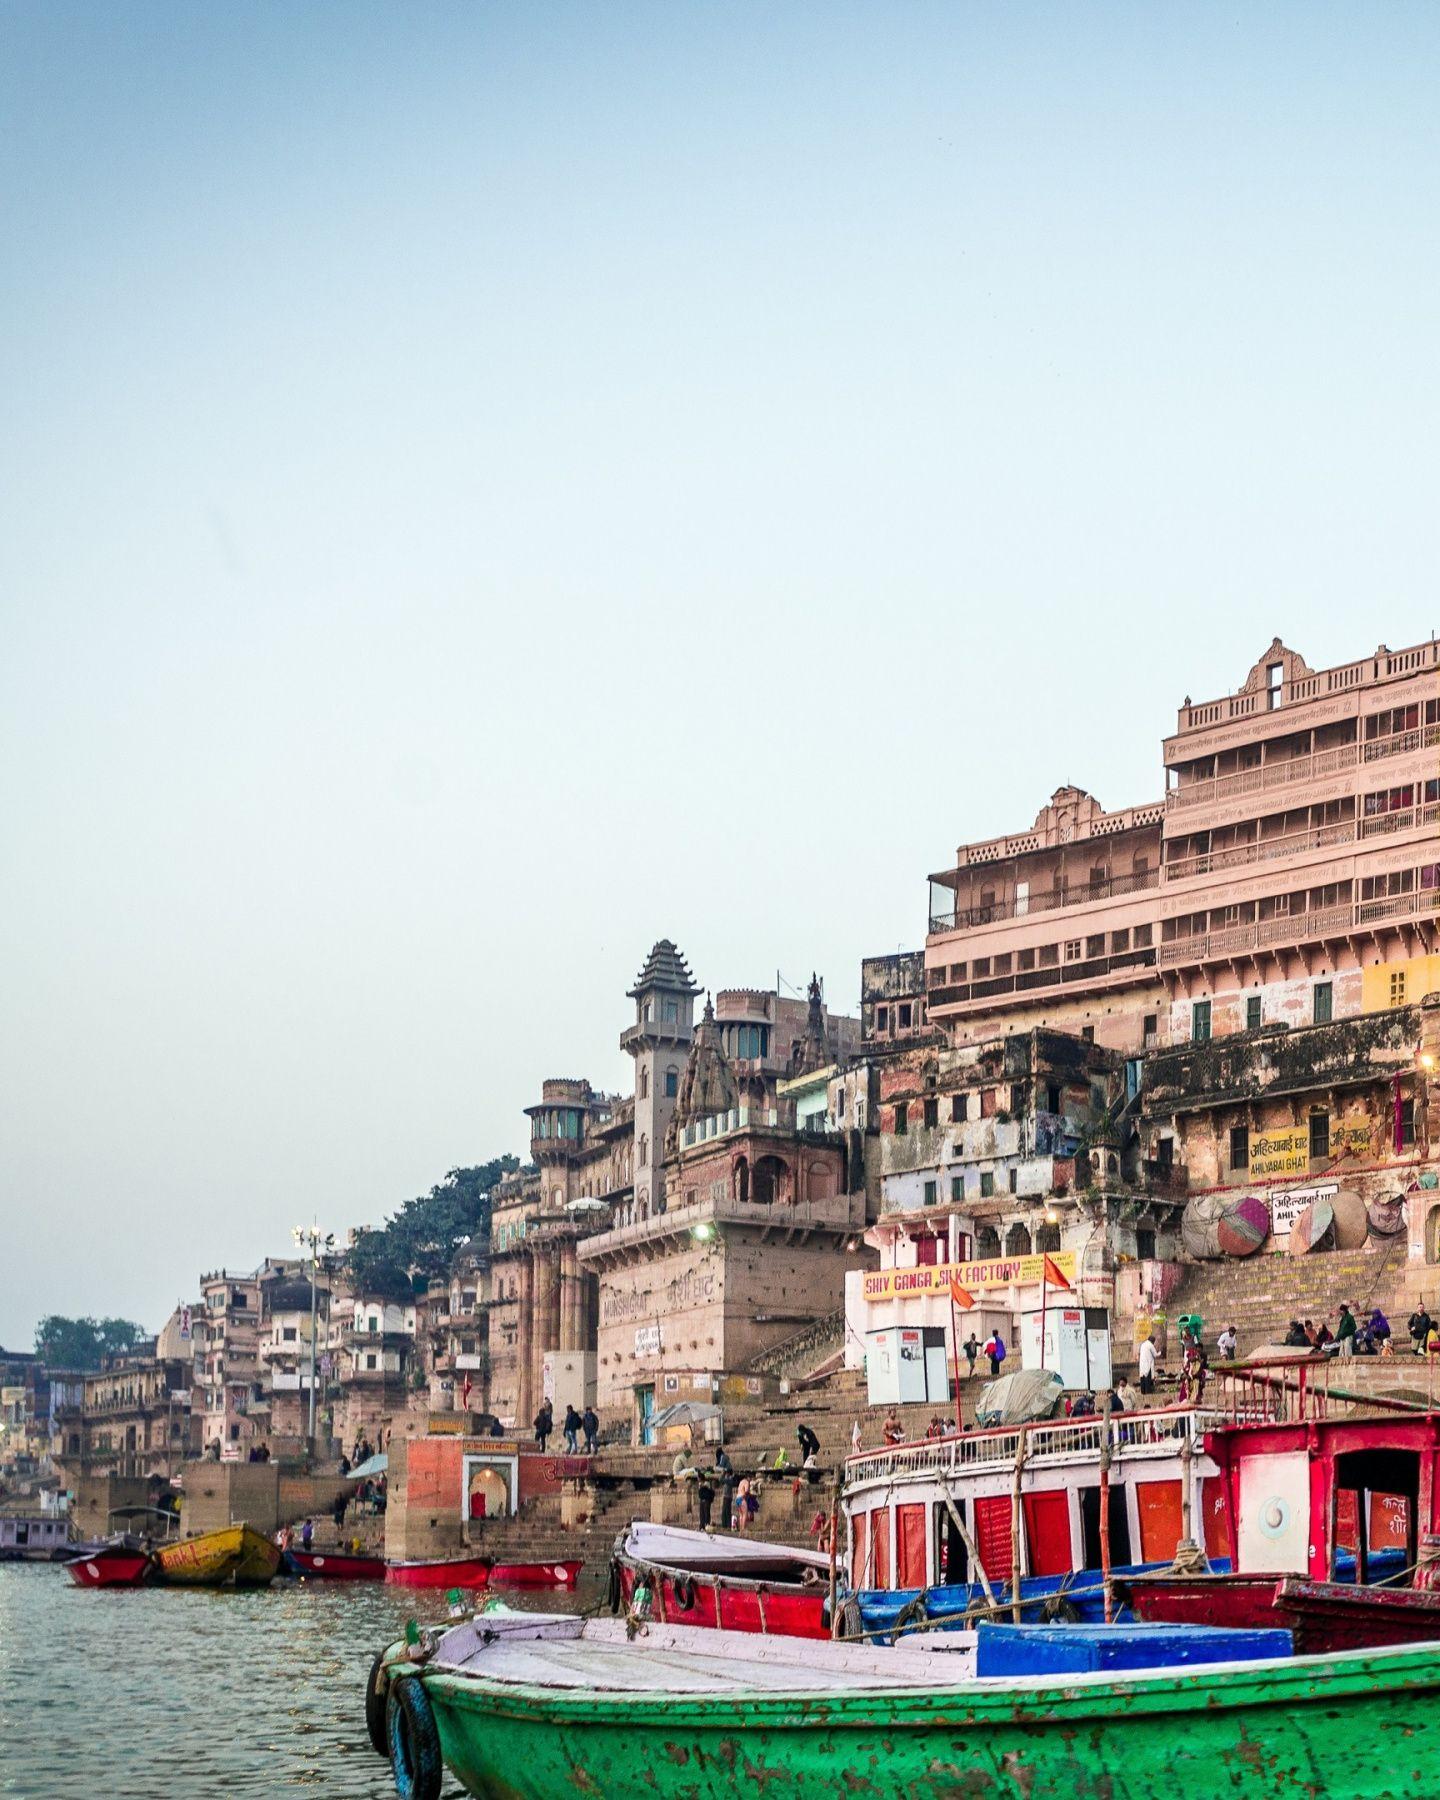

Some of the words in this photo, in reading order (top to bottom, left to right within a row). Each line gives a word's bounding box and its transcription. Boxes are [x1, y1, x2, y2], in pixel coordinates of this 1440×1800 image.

[1286, 1155, 1308, 1170] GHAT
[866, 1277, 890, 1294] SHIV
[894, 1271, 932, 1290] GANGA
[966, 1262, 1021, 1283] FACTORY
